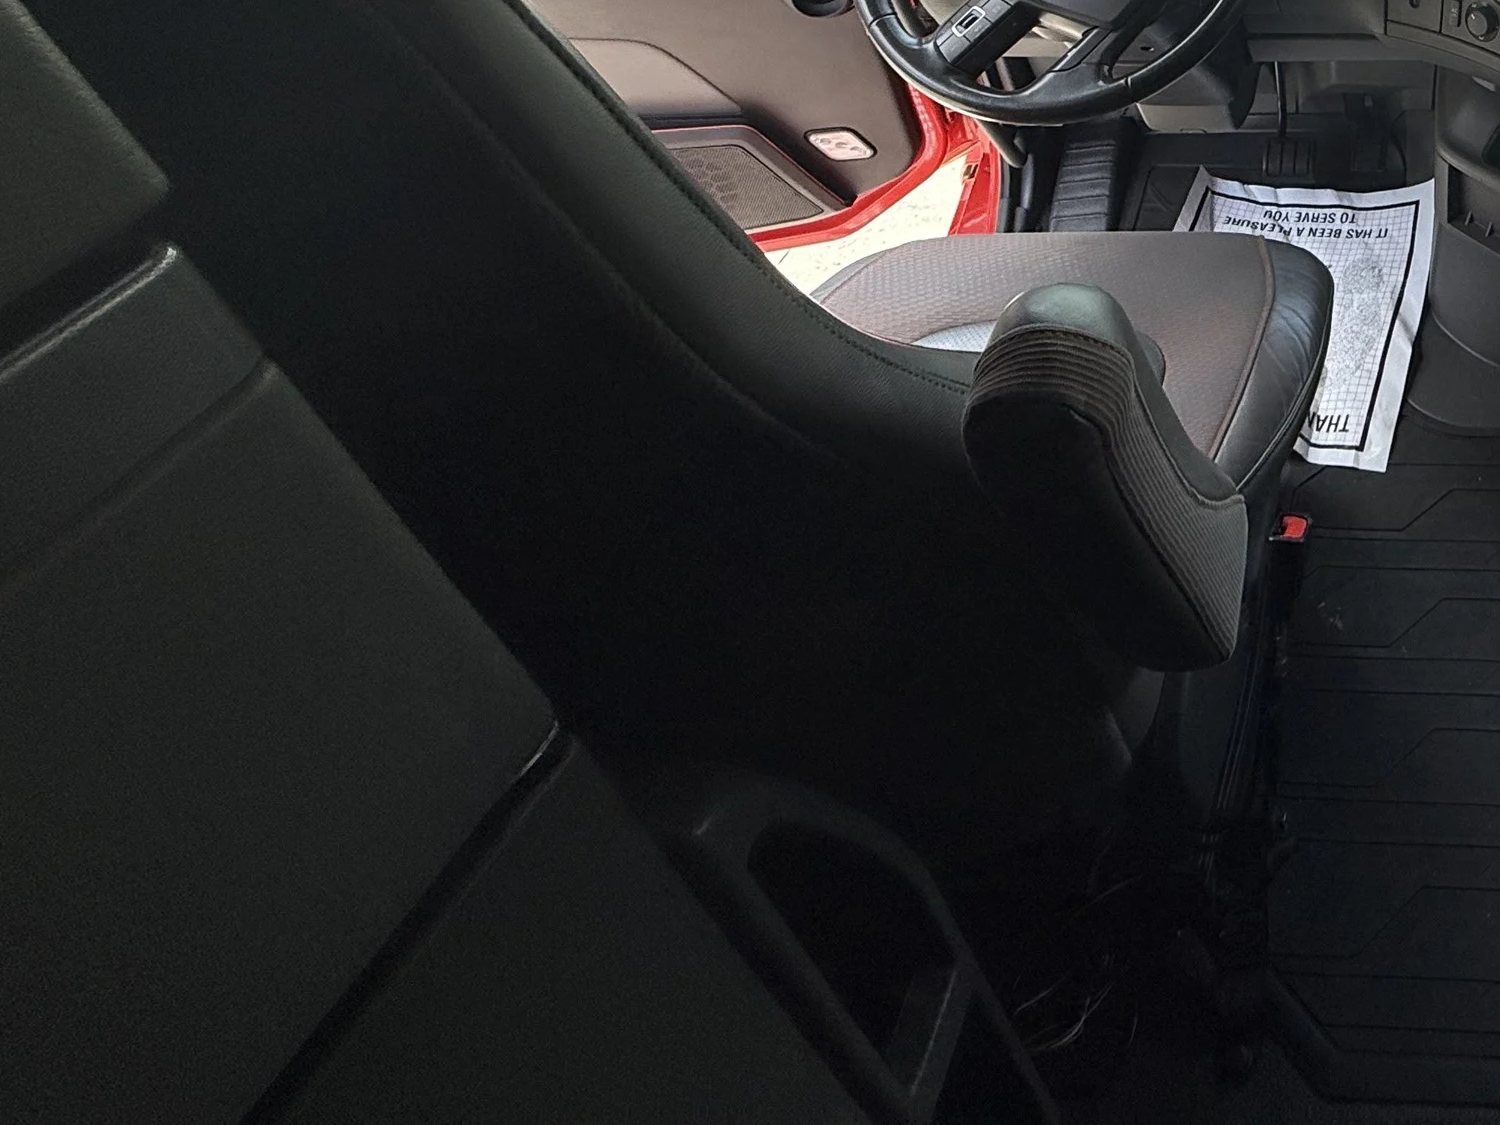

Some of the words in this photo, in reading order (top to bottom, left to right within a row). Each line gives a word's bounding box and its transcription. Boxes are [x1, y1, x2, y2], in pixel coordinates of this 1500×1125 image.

[1263, 210, 1290, 223] YOU
[1295, 211, 1336, 224] SERVE
[1339, 212, 1357, 224] TO
[1224, 215, 1292, 237] PLEASURE
[1296, 227, 1305, 237] A
[1307, 227, 1342, 239] BEEN
[1345, 228, 1373, 239] HAS
[1375, 228, 1388, 239] IT
[1308, 411, 1349, 433] THAN
